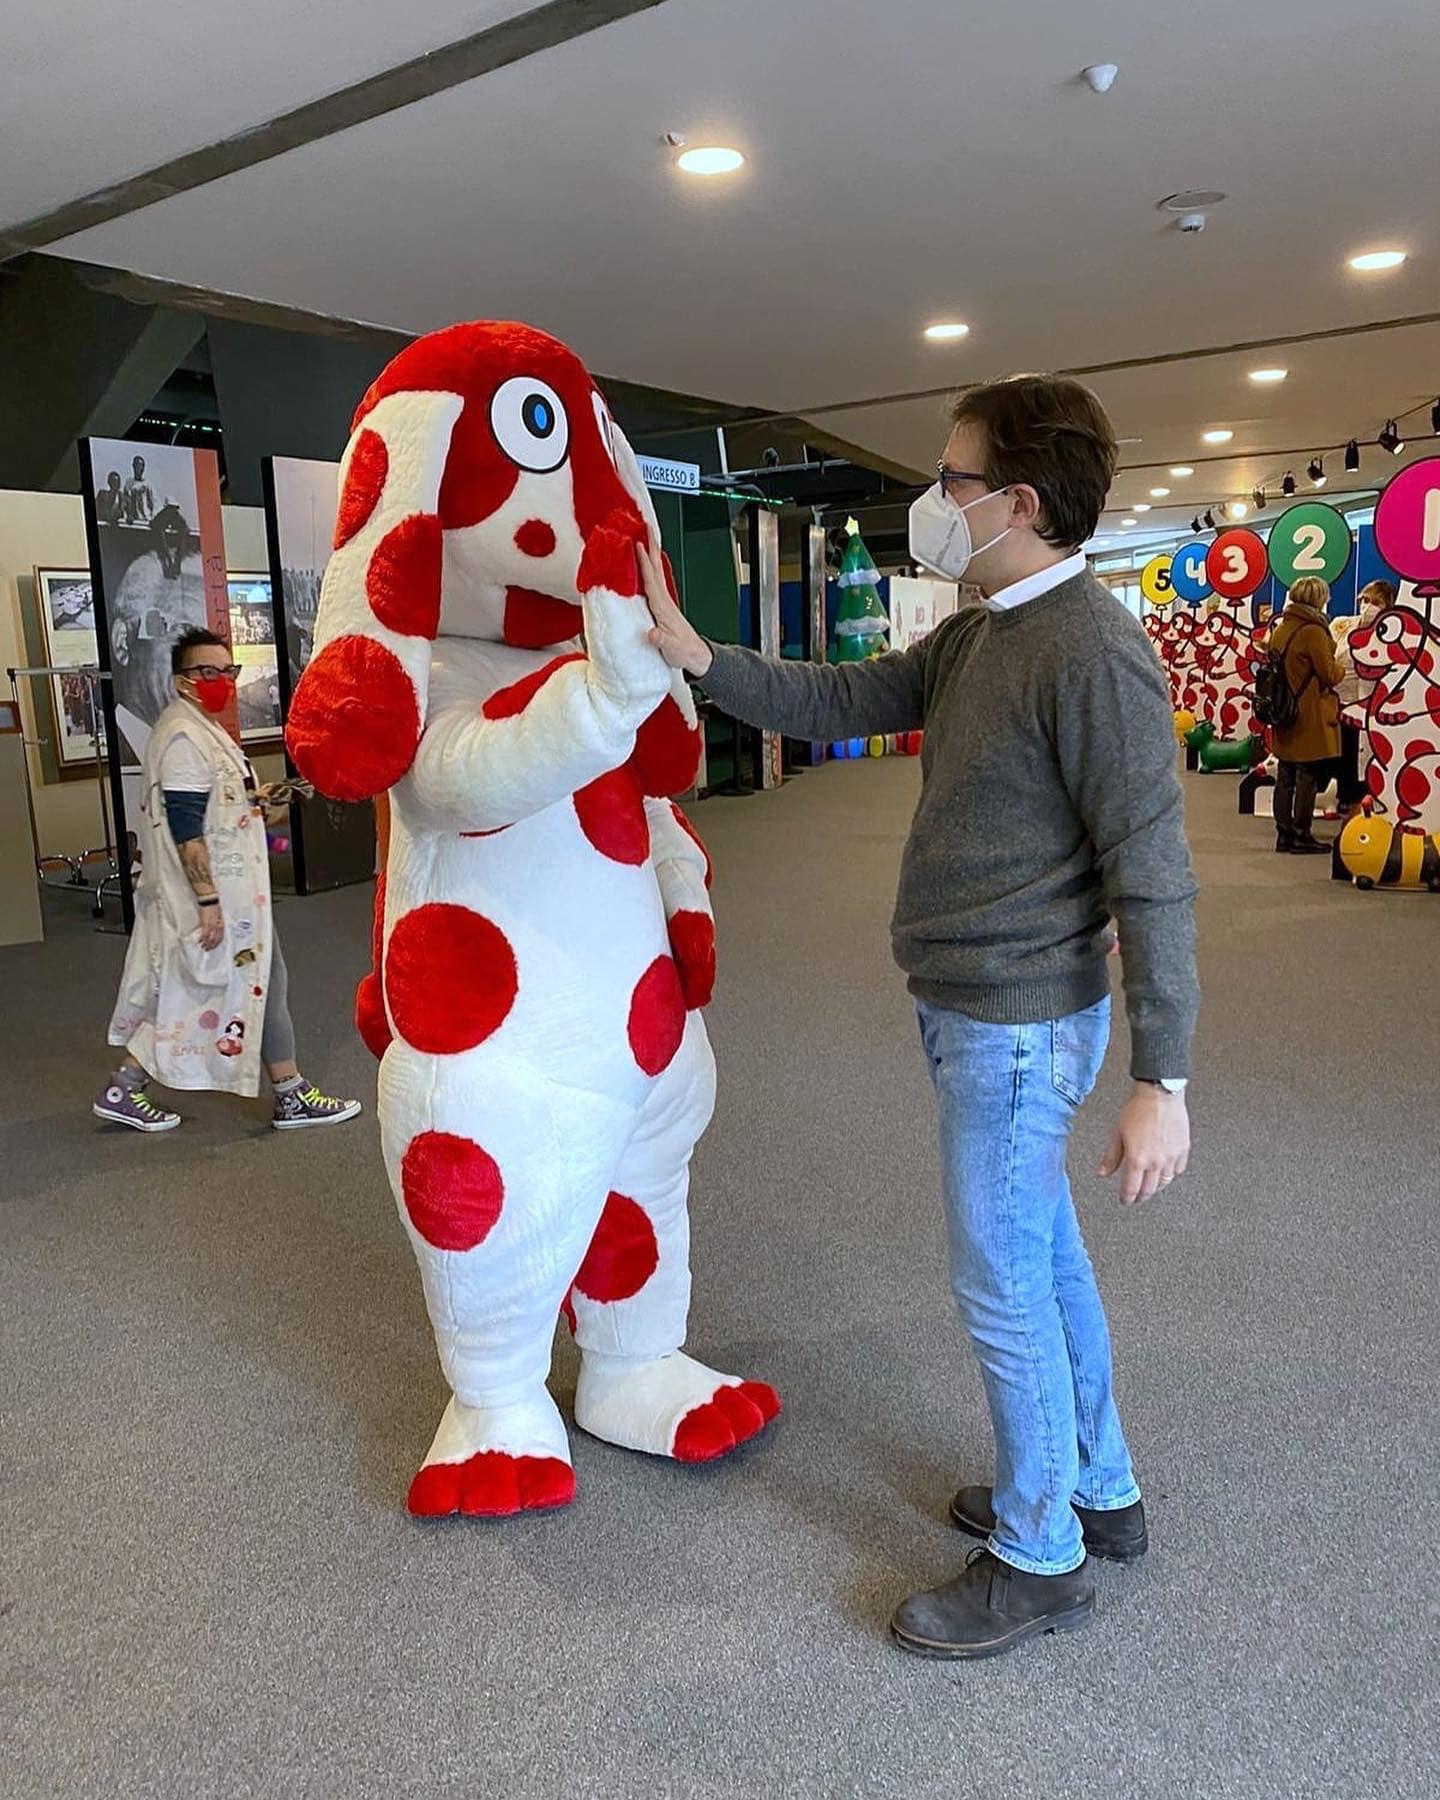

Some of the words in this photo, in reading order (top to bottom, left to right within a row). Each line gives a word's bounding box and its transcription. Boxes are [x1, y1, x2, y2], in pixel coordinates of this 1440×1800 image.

[643, 463, 687, 485] INGRESSO
[1423, 488, 1440, 552] 1
[1220, 545, 1249, 583] 3
[1292, 524, 1326, 571] 2
[1154, 568, 1171, 591] 5
[1185, 556, 1206, 587] 4
